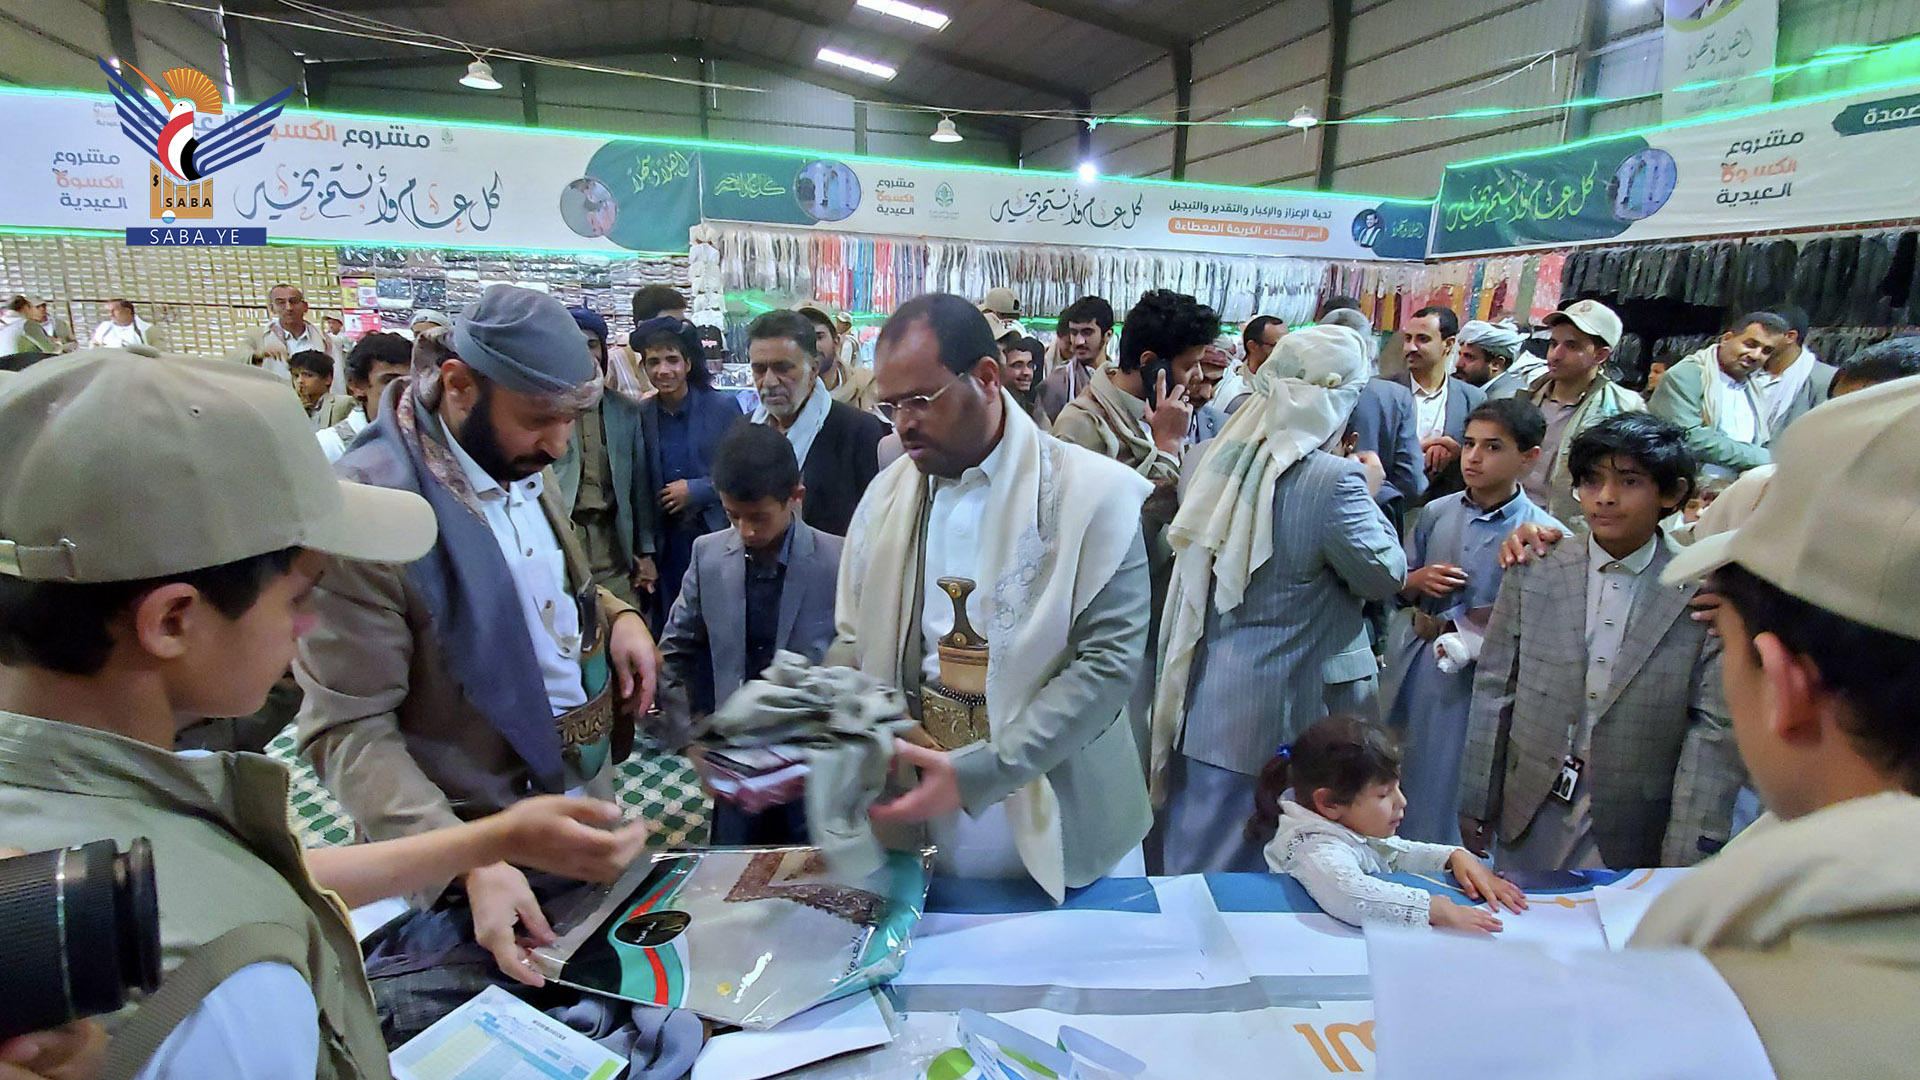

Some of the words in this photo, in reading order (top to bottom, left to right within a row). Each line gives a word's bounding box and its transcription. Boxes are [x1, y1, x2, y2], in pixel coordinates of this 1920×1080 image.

[343, 125, 430, 149] مشروع
[1725, 129, 1804, 158] مشروع
[53, 148, 121, 166] مشروع
[52, 168, 125, 190] الكسوة
[1721, 156, 1797, 184] الكسوة
[877, 177, 915, 188] مشروع
[60, 192, 128, 212] العيدية
[233, 167, 321, 221] بخير
[399, 177, 474, 233] عام
[469, 170, 503, 231] كل
[1716, 182, 1792, 208] العيدية
[877, 203, 914, 216] العيدية
[1122, 192, 1143, 229] كل
[1169, 200, 1209, 213] والتبجيل
[1211, 203, 1249, 215] والتقدير
[1312, 209, 1332, 220] تحية
[1264, 226, 1305, 238] الشهداء
